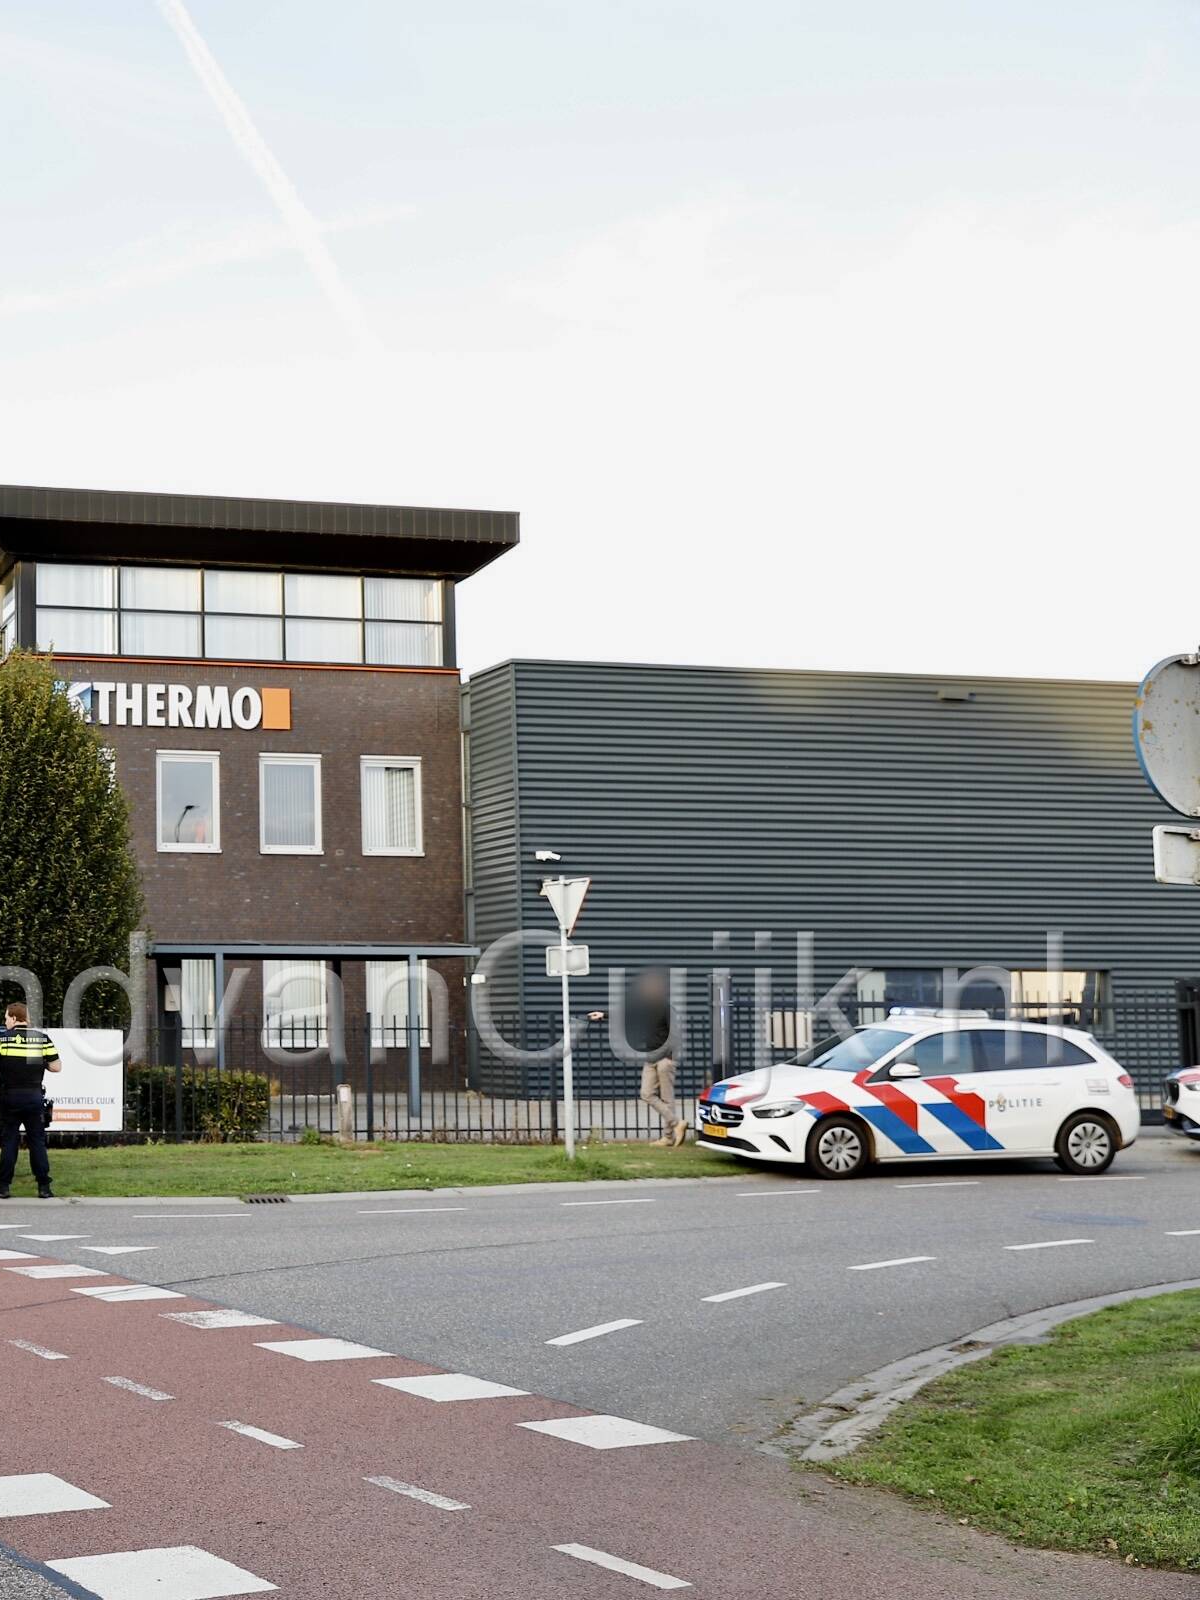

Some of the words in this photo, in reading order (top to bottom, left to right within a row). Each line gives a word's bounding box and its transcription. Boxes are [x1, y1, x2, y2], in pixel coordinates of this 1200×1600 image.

[93, 681, 263, 730] THERMO
[95, 1096, 116, 1105] CUIJK
[988, 1097, 1043, 1113] POLITIE
